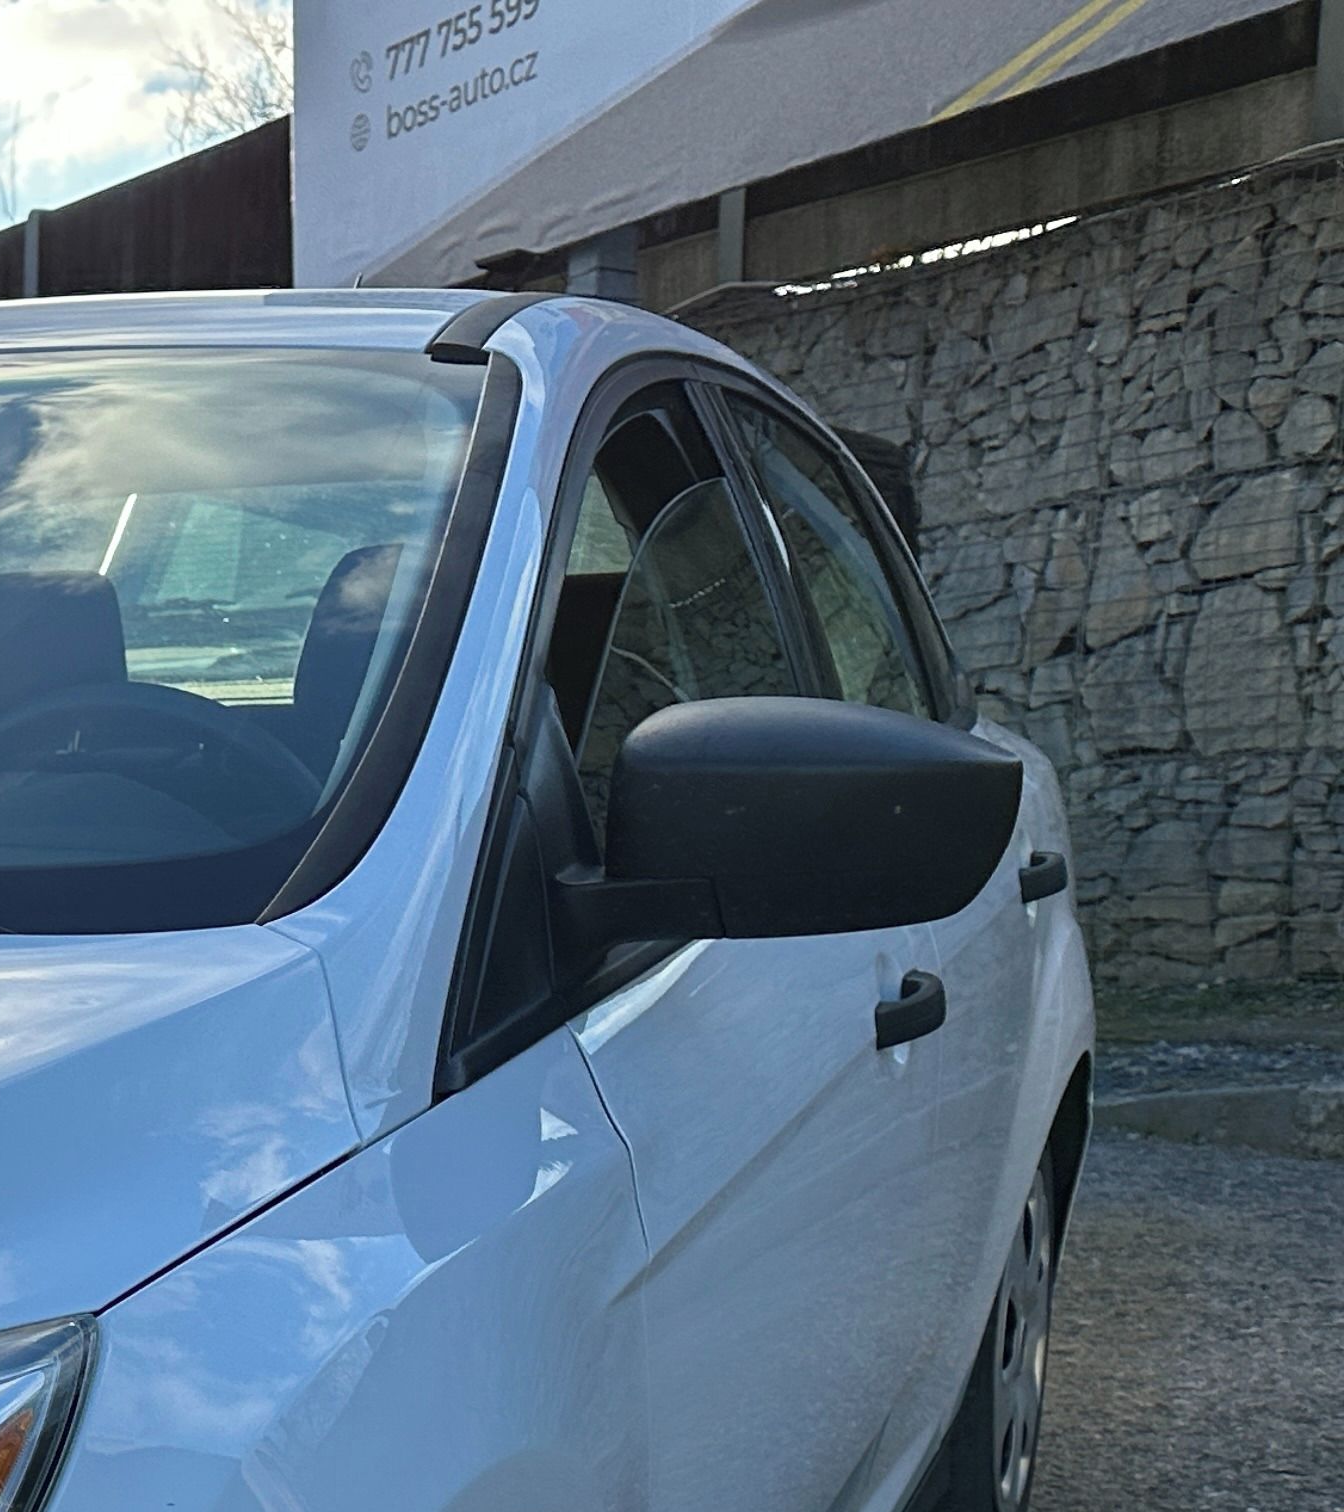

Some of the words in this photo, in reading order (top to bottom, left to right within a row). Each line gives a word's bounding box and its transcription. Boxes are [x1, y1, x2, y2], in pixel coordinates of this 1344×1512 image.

[386, 28, 431, 80] 777
[437, 5, 482, 57] 755
[387, 51, 539, 139] boss-auto.cz
